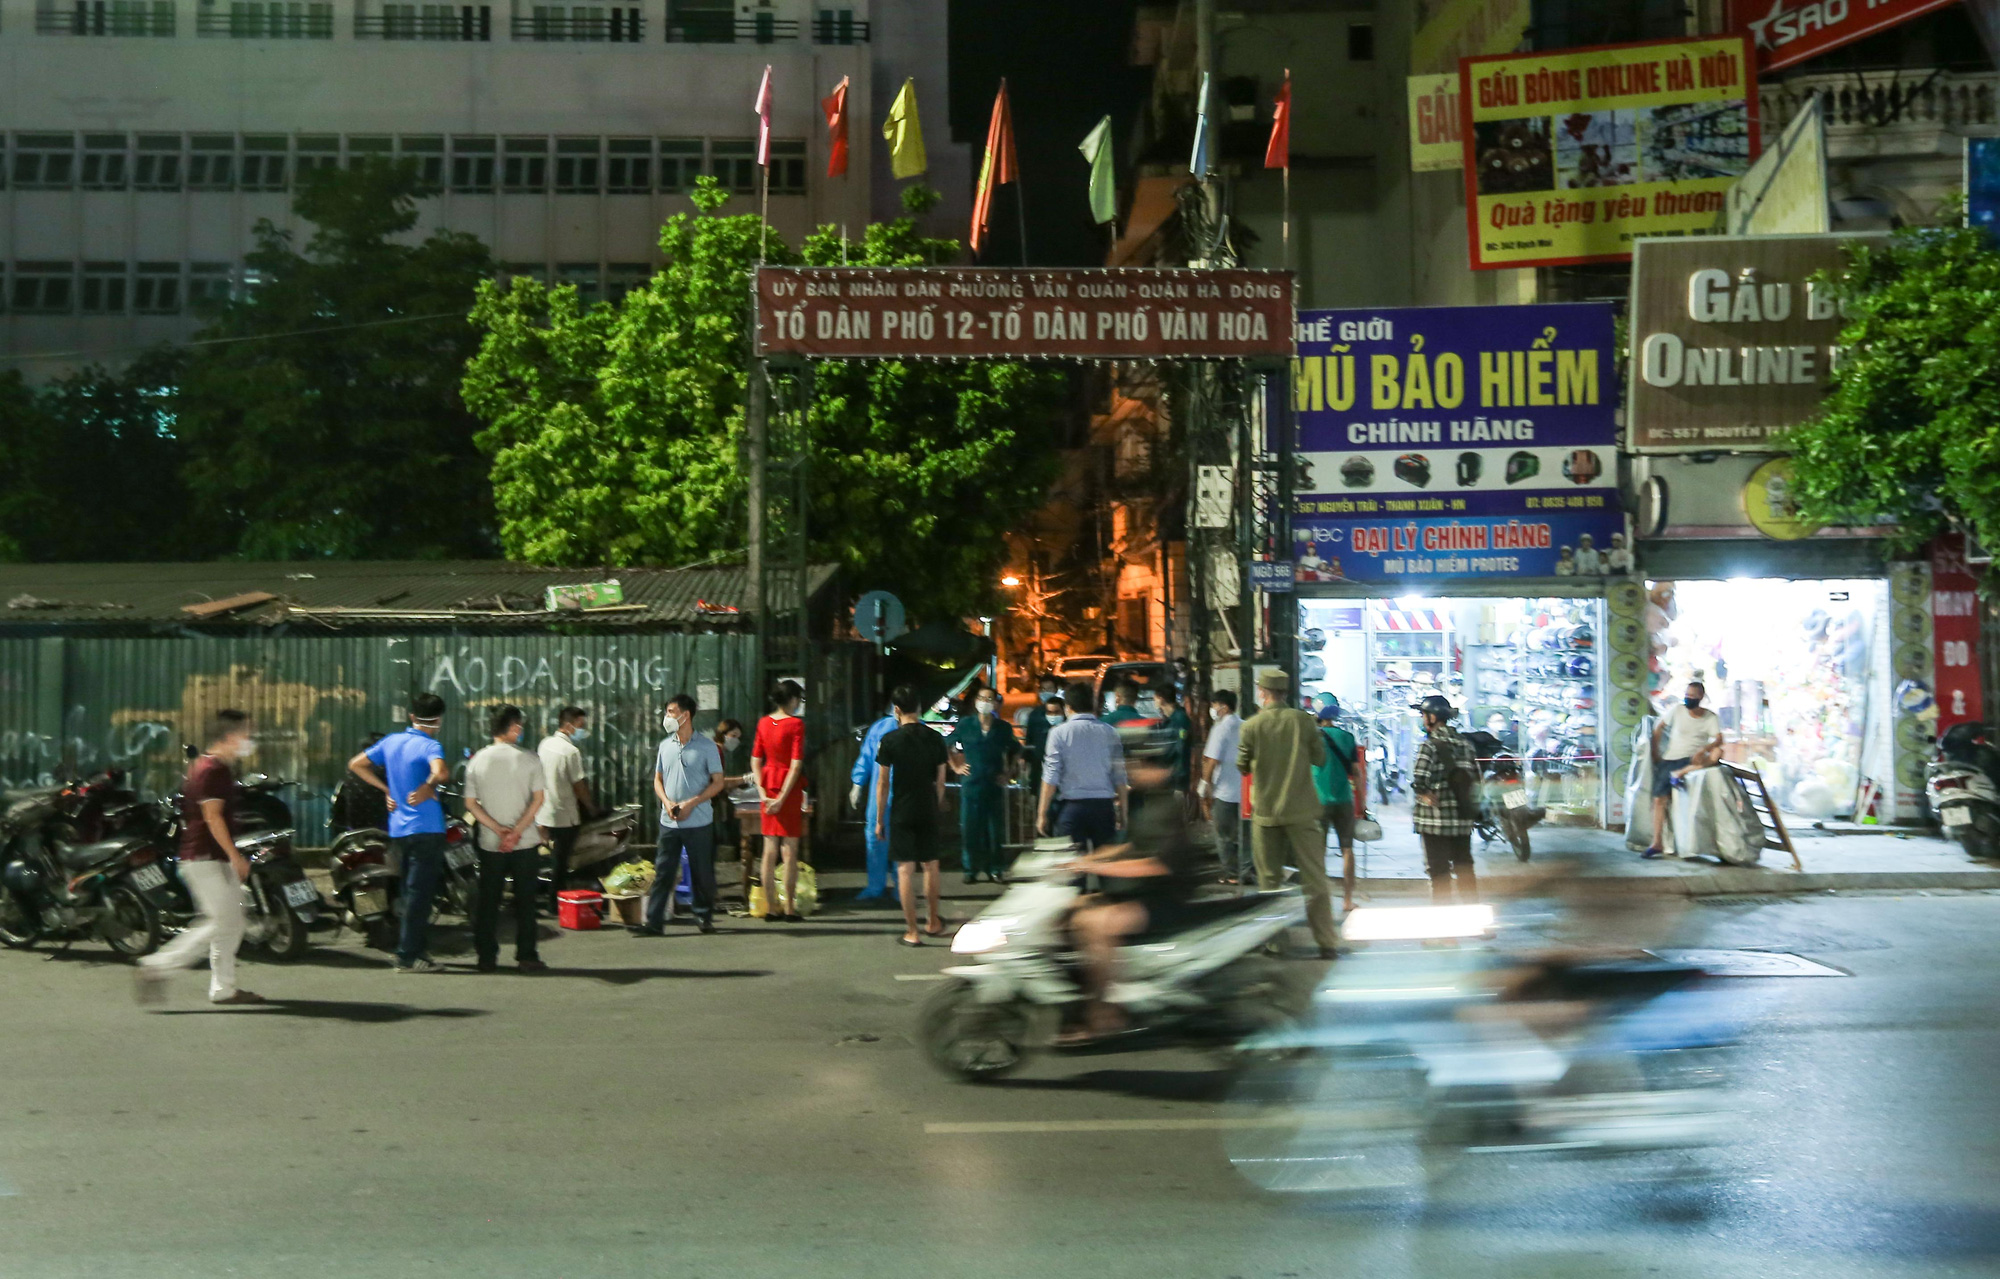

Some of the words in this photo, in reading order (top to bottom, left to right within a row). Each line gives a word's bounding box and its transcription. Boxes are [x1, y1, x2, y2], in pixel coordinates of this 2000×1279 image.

[1478, 67, 1519, 108] GẤU
[1525, 66, 1581, 103] BÔNG
[1587, 61, 1661, 99] ONLINE
[1666, 53, 1694, 91] HÀ
[1699, 50, 1737, 95] NỘI
[1490, 200, 1536, 230] Quà
[1543, 197, 1596, 228] tặng
[1603, 193, 1647, 223] yêu
[805, 282, 841, 297] BAN
[849, 280, 898, 298] NHÂN
[904, 279, 942, 298] DÂN
[950, 279, 1024, 299] PHƯỜNG
[1033, 281, 1069, 299] VĂN
[1197, 280, 1222, 298] HÀ
[1689, 267, 1792, 323] GẤU
[773, 300, 808, 340] TỔ
[816, 304, 870, 340] DÂN
[882, 303, 938, 340] PHỐ
[1033, 305, 1087, 340] DÂN
[1097, 305, 1152, 341] PHỐ
[1158, 305, 1208, 340] VĂN
[1298, 315, 1332, 343] HẾ
[1339, 316, 1394, 342] GIỚI
[1290, 343, 1356, 412] MŨ
[1370, 333, 1465, 409] BẢO
[1479, 326, 1600, 407] HIỂM
[1347, 418, 1442, 444] CHÍNH
[1352, 526, 1389, 557] ĐẠI
[1393, 521, 1419, 551] LÝ
[1423, 520, 1489, 551] CHÍNH
[1407, 554, 1434, 574] BẢO
[1436, 552, 1469, 573] HIỂM
[1470, 556, 1520, 572] PROTEC
[573, 645, 671, 692] BÓNG
